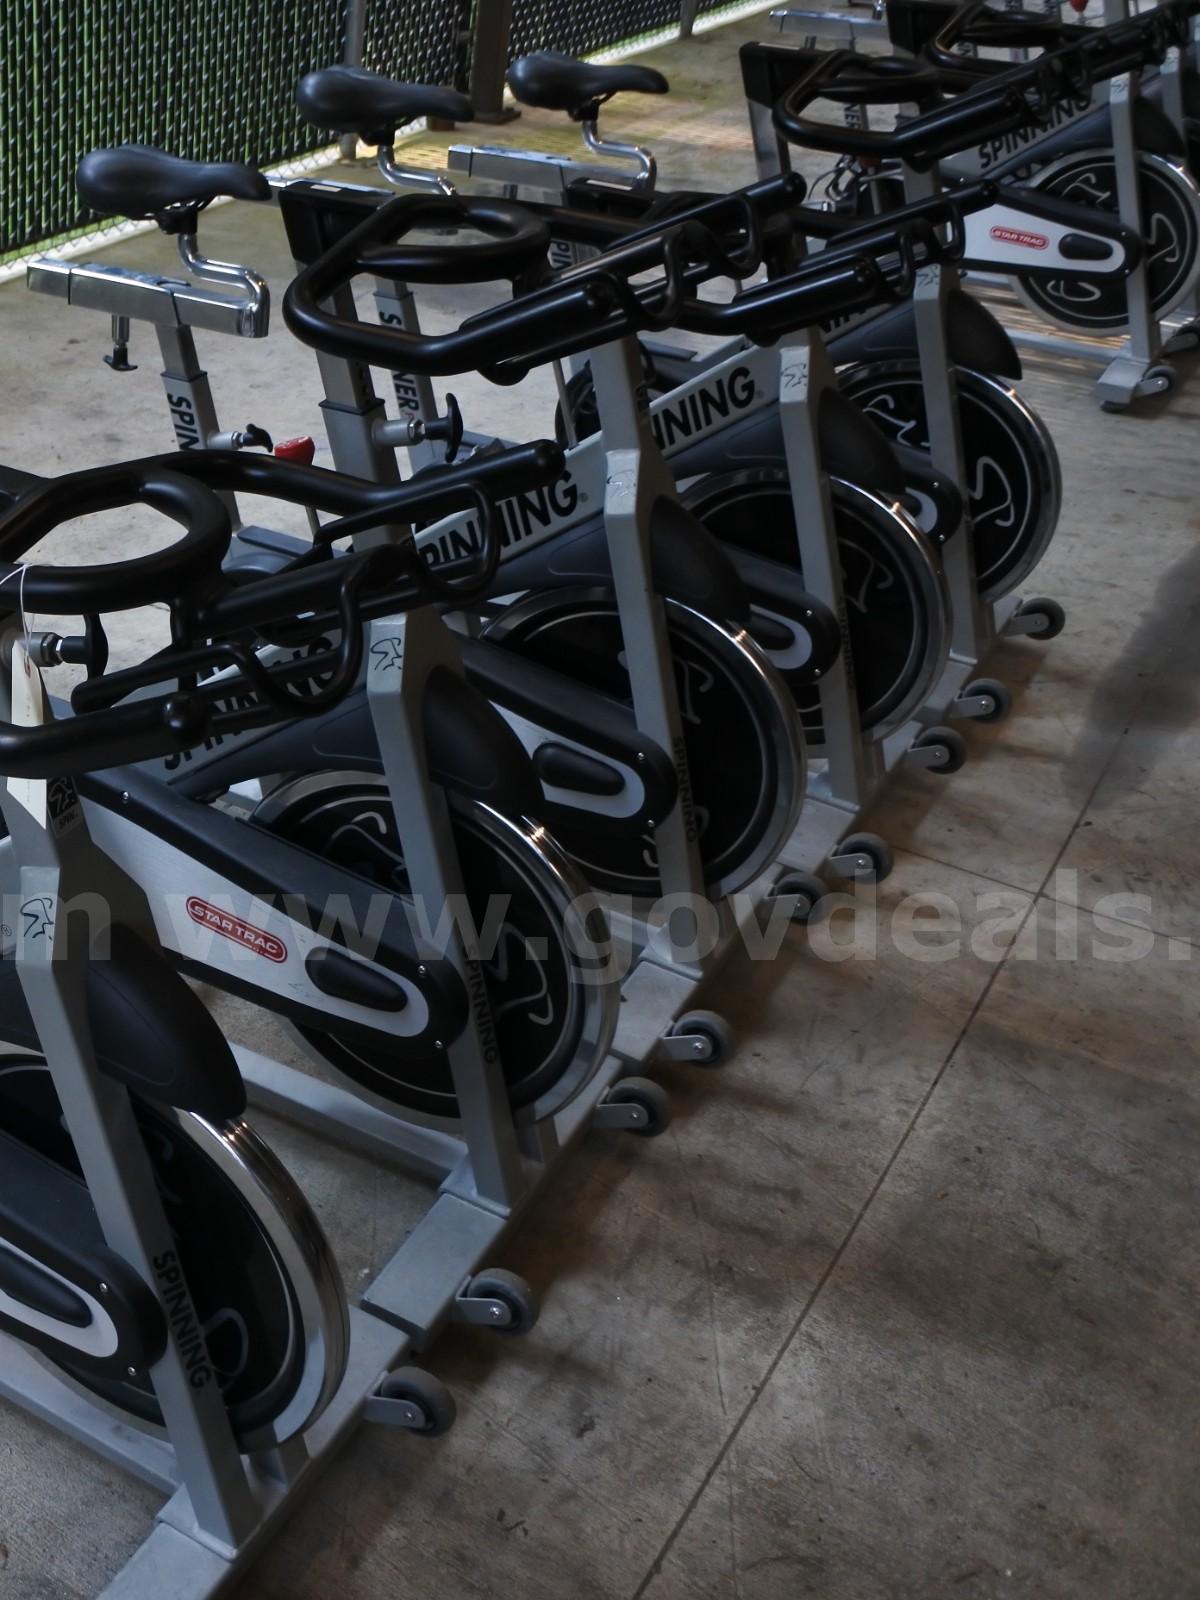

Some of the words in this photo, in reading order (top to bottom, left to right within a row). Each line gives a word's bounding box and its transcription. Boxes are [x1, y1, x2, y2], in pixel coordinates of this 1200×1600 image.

[994, 230, 1018, 242] STAR
[190, 905, 233, 931] STAR
[236, 926, 278, 954] TRAC
[153, 1249, 212, 1389] SPINNING
